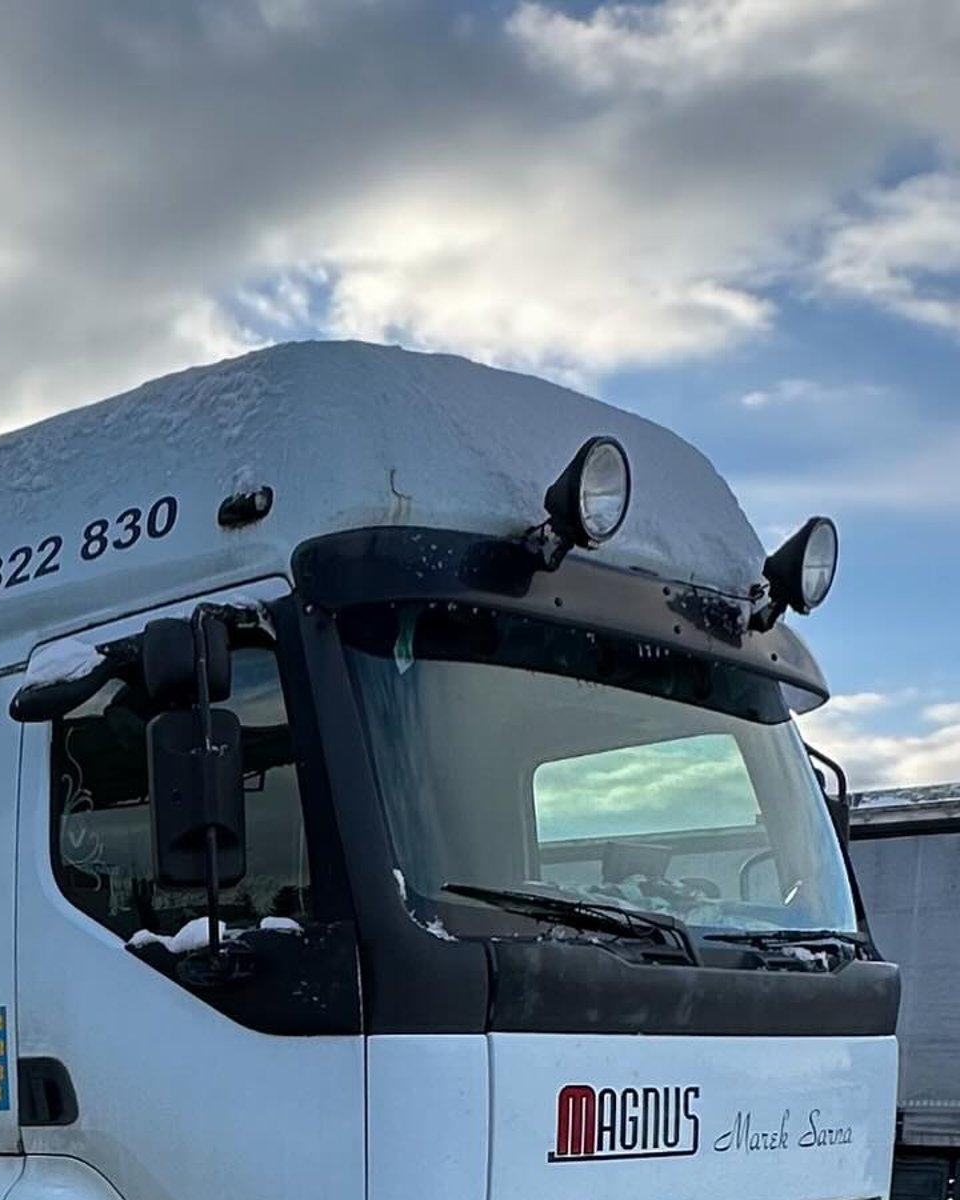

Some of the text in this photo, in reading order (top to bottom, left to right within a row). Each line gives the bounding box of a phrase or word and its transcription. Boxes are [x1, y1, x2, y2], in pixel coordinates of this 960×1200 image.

[80, 496, 178, 561] 830
[547, 1084, 700, 1163] MAGNUS
[714, 1109, 790, 1154] Marek
